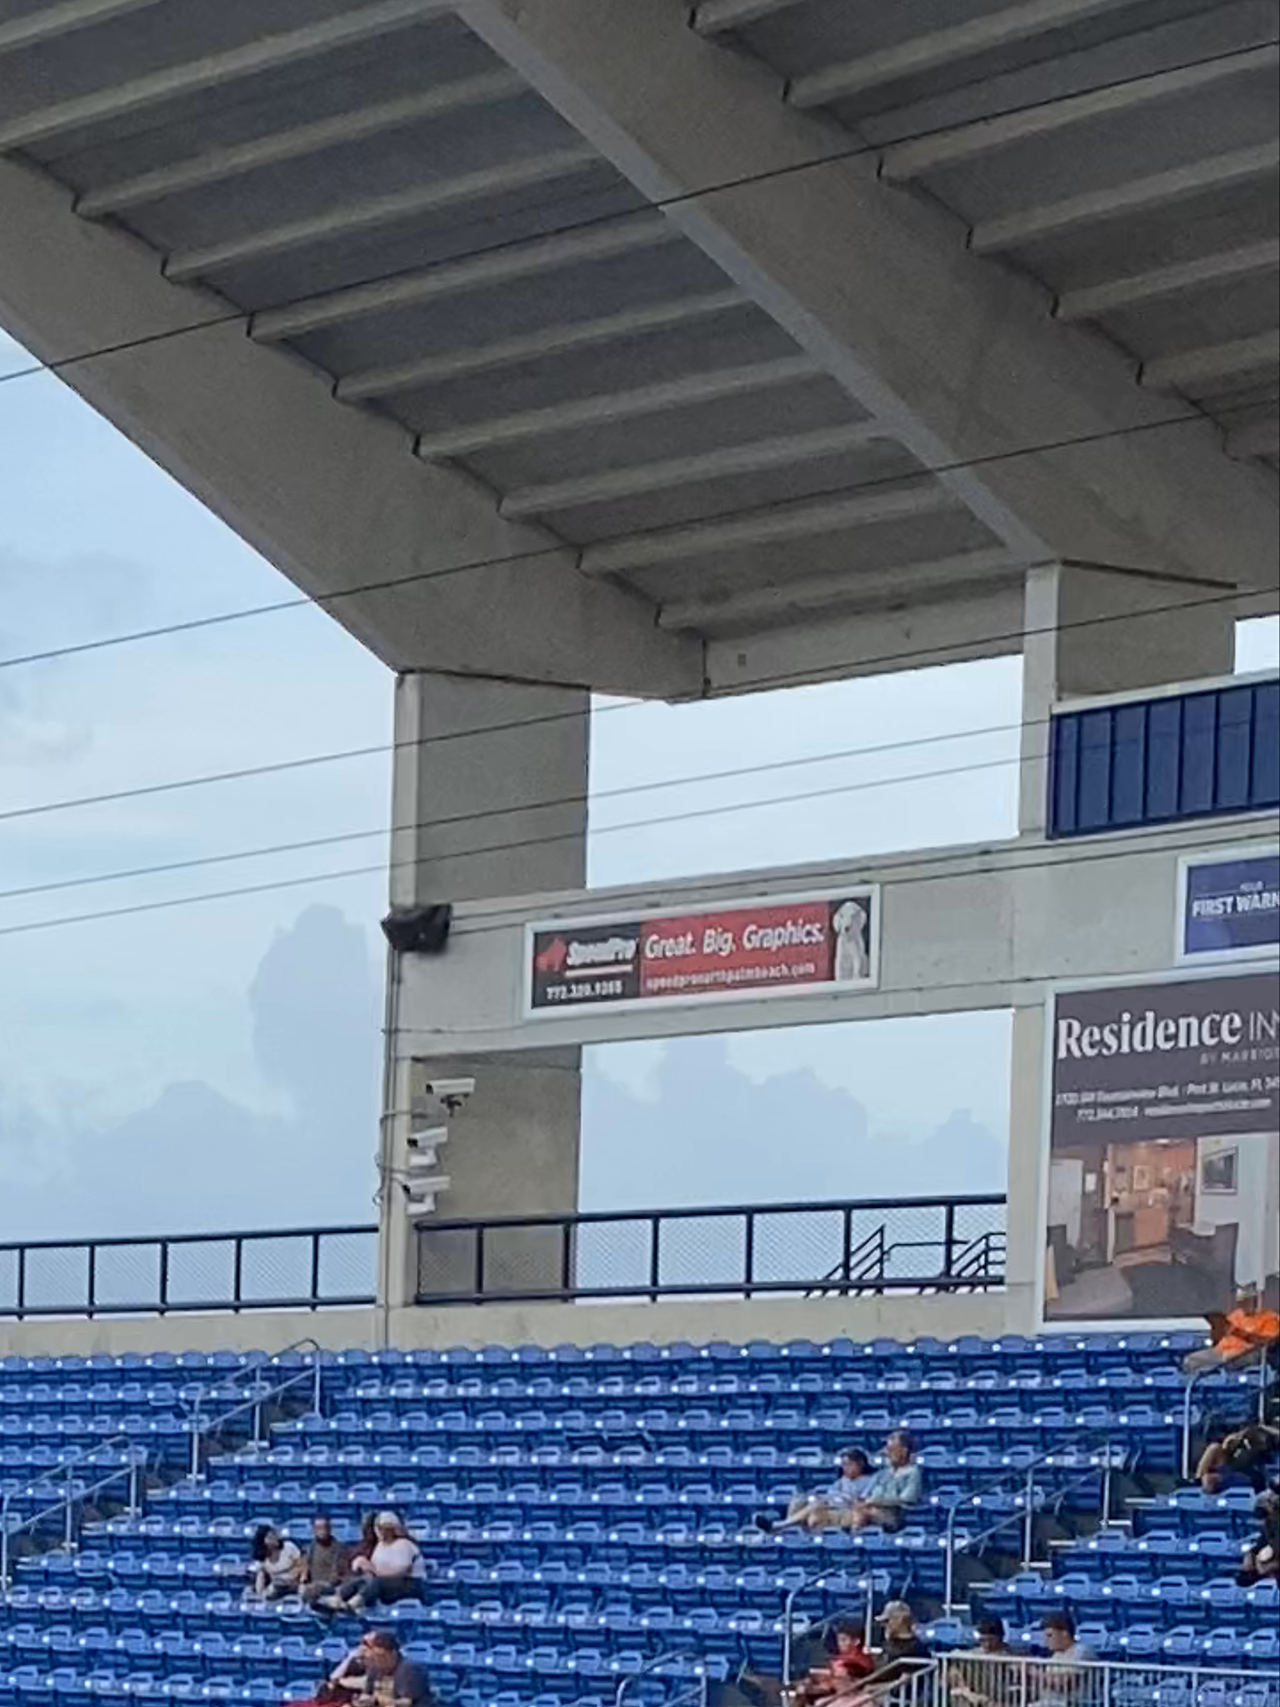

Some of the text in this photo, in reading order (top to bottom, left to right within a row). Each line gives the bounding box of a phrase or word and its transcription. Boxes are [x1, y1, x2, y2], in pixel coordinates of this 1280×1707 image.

[1192, 896, 1233, 918] FIRST
[644, 918, 825, 960] Great. Big. Graphics.
[1057, 1010, 1242, 1060] Residence
